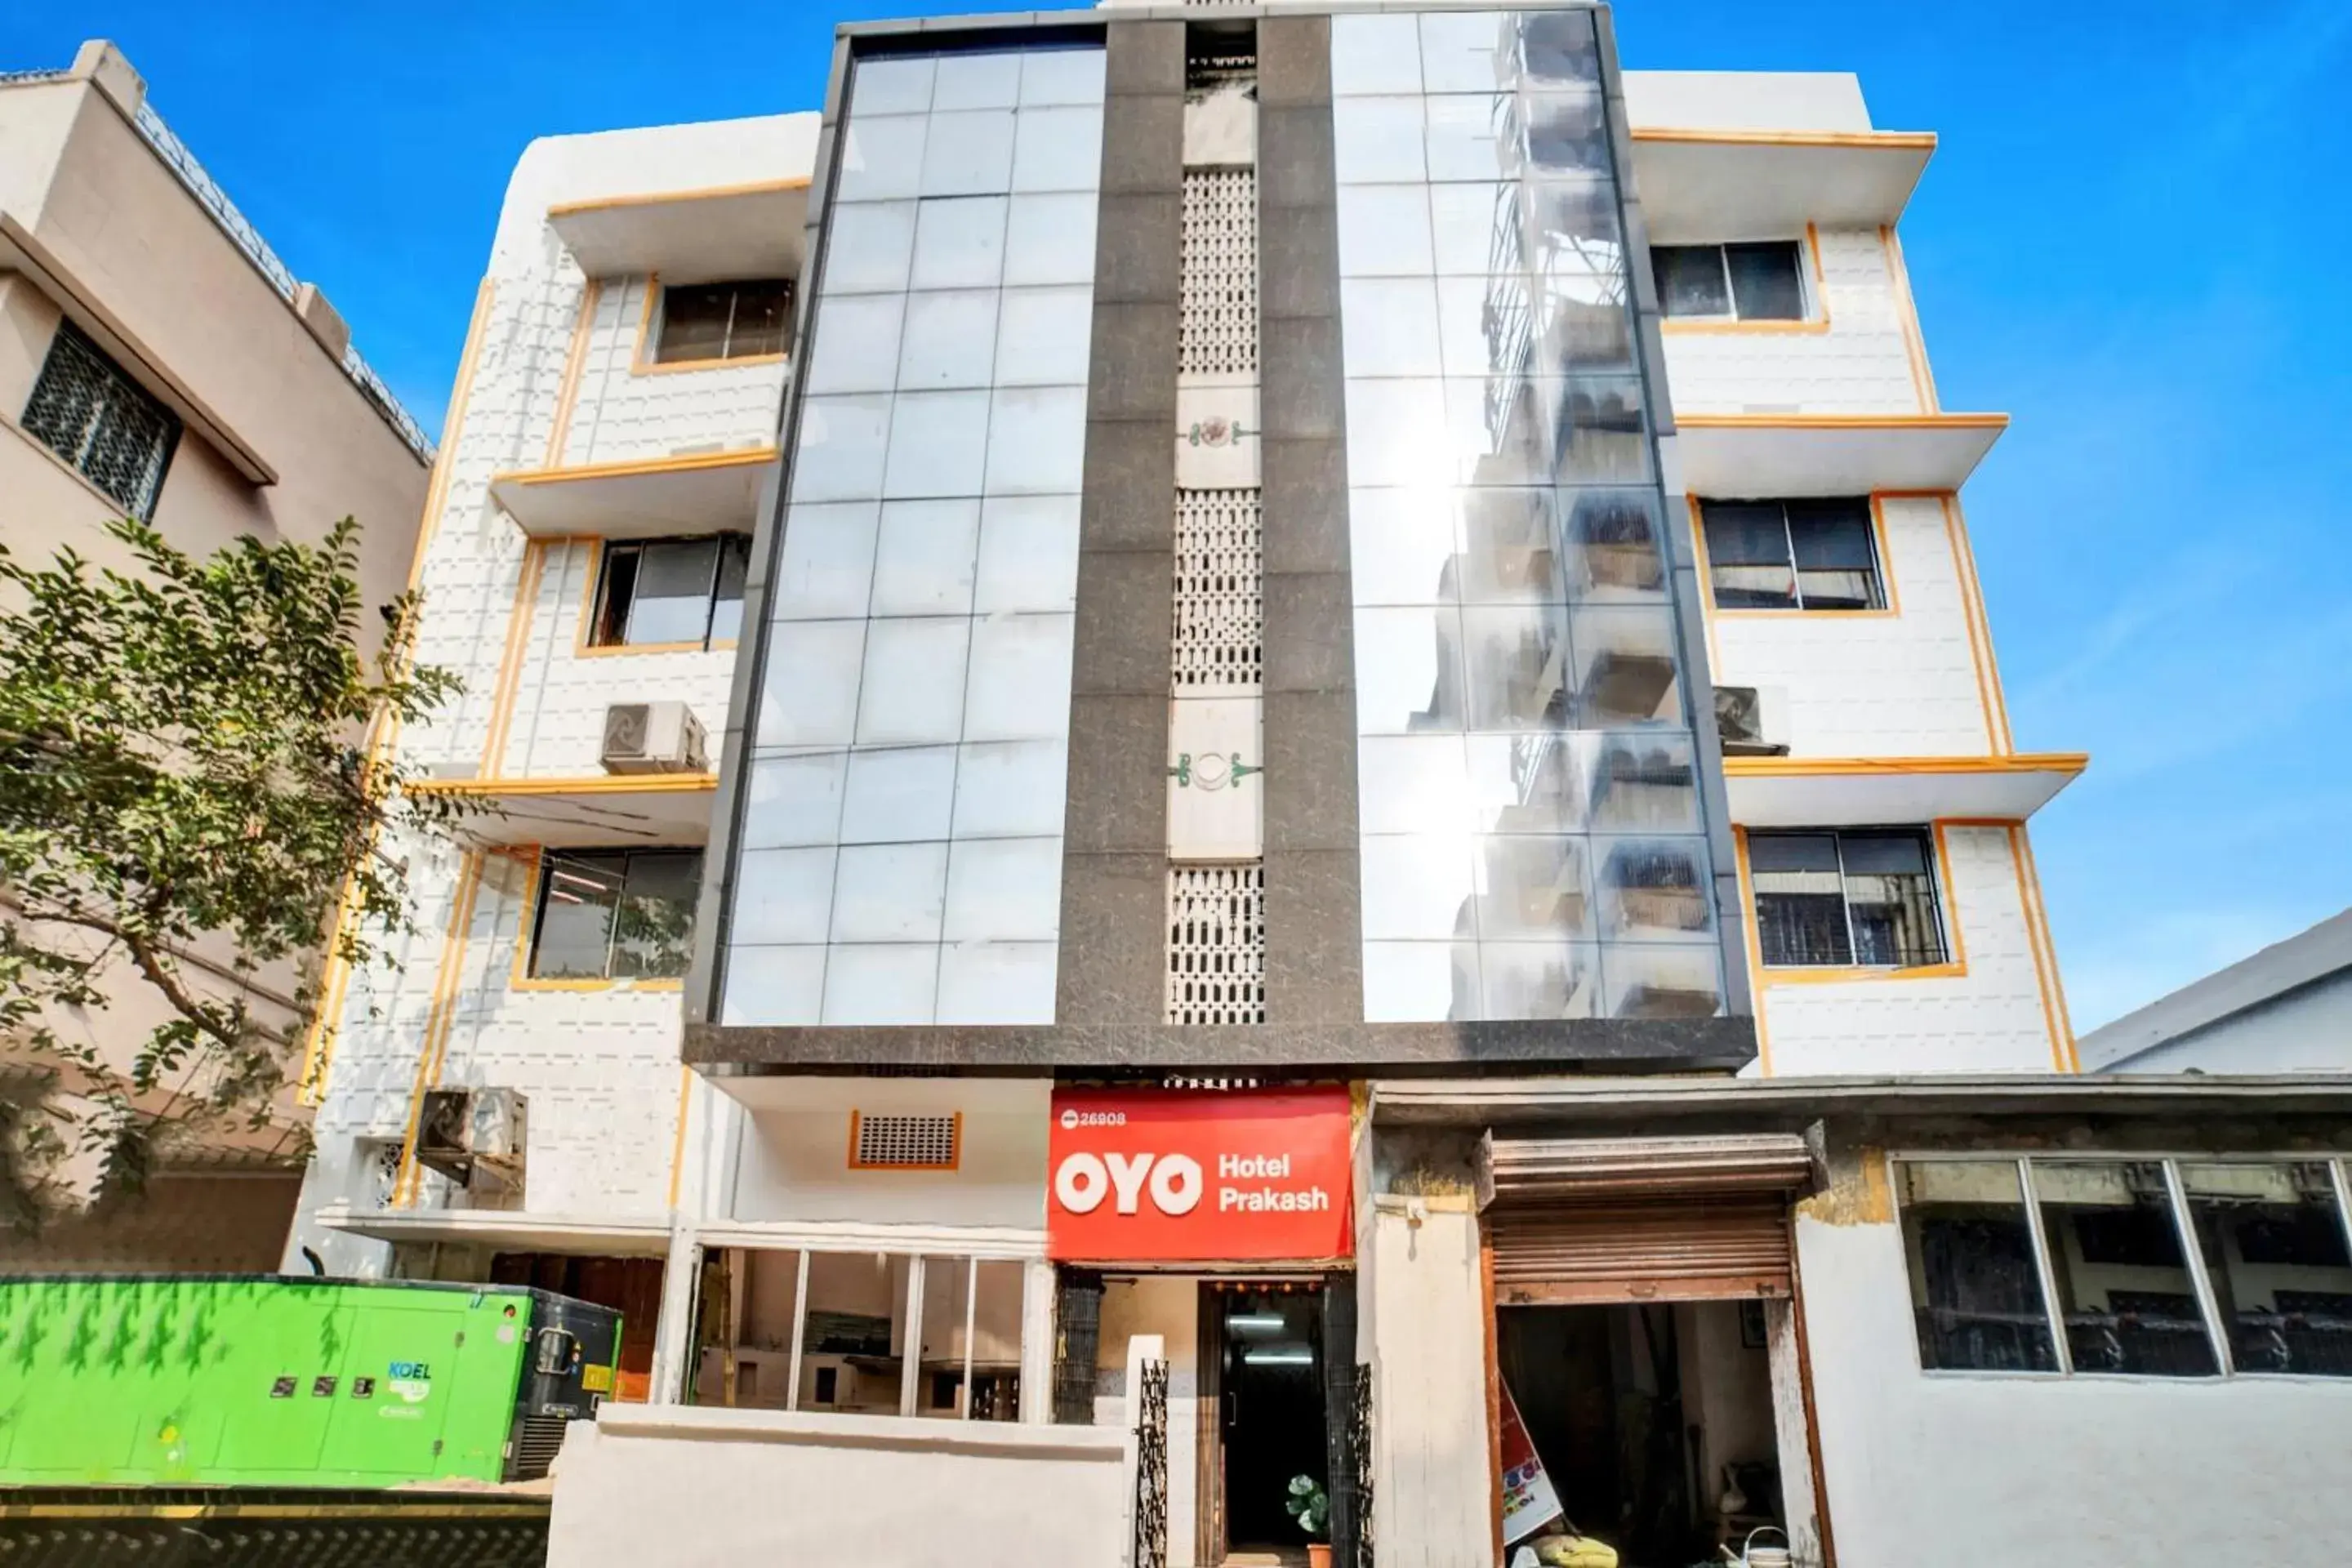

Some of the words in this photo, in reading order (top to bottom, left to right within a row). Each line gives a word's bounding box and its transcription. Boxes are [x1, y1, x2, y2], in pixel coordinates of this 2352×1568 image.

[1218, 1153, 1290, 1178] Hotel
[1055, 1152, 1203, 1214] OYO
[1219, 1186, 1329, 1213] Prakash
[389, 1362, 431, 1379] KOEL
